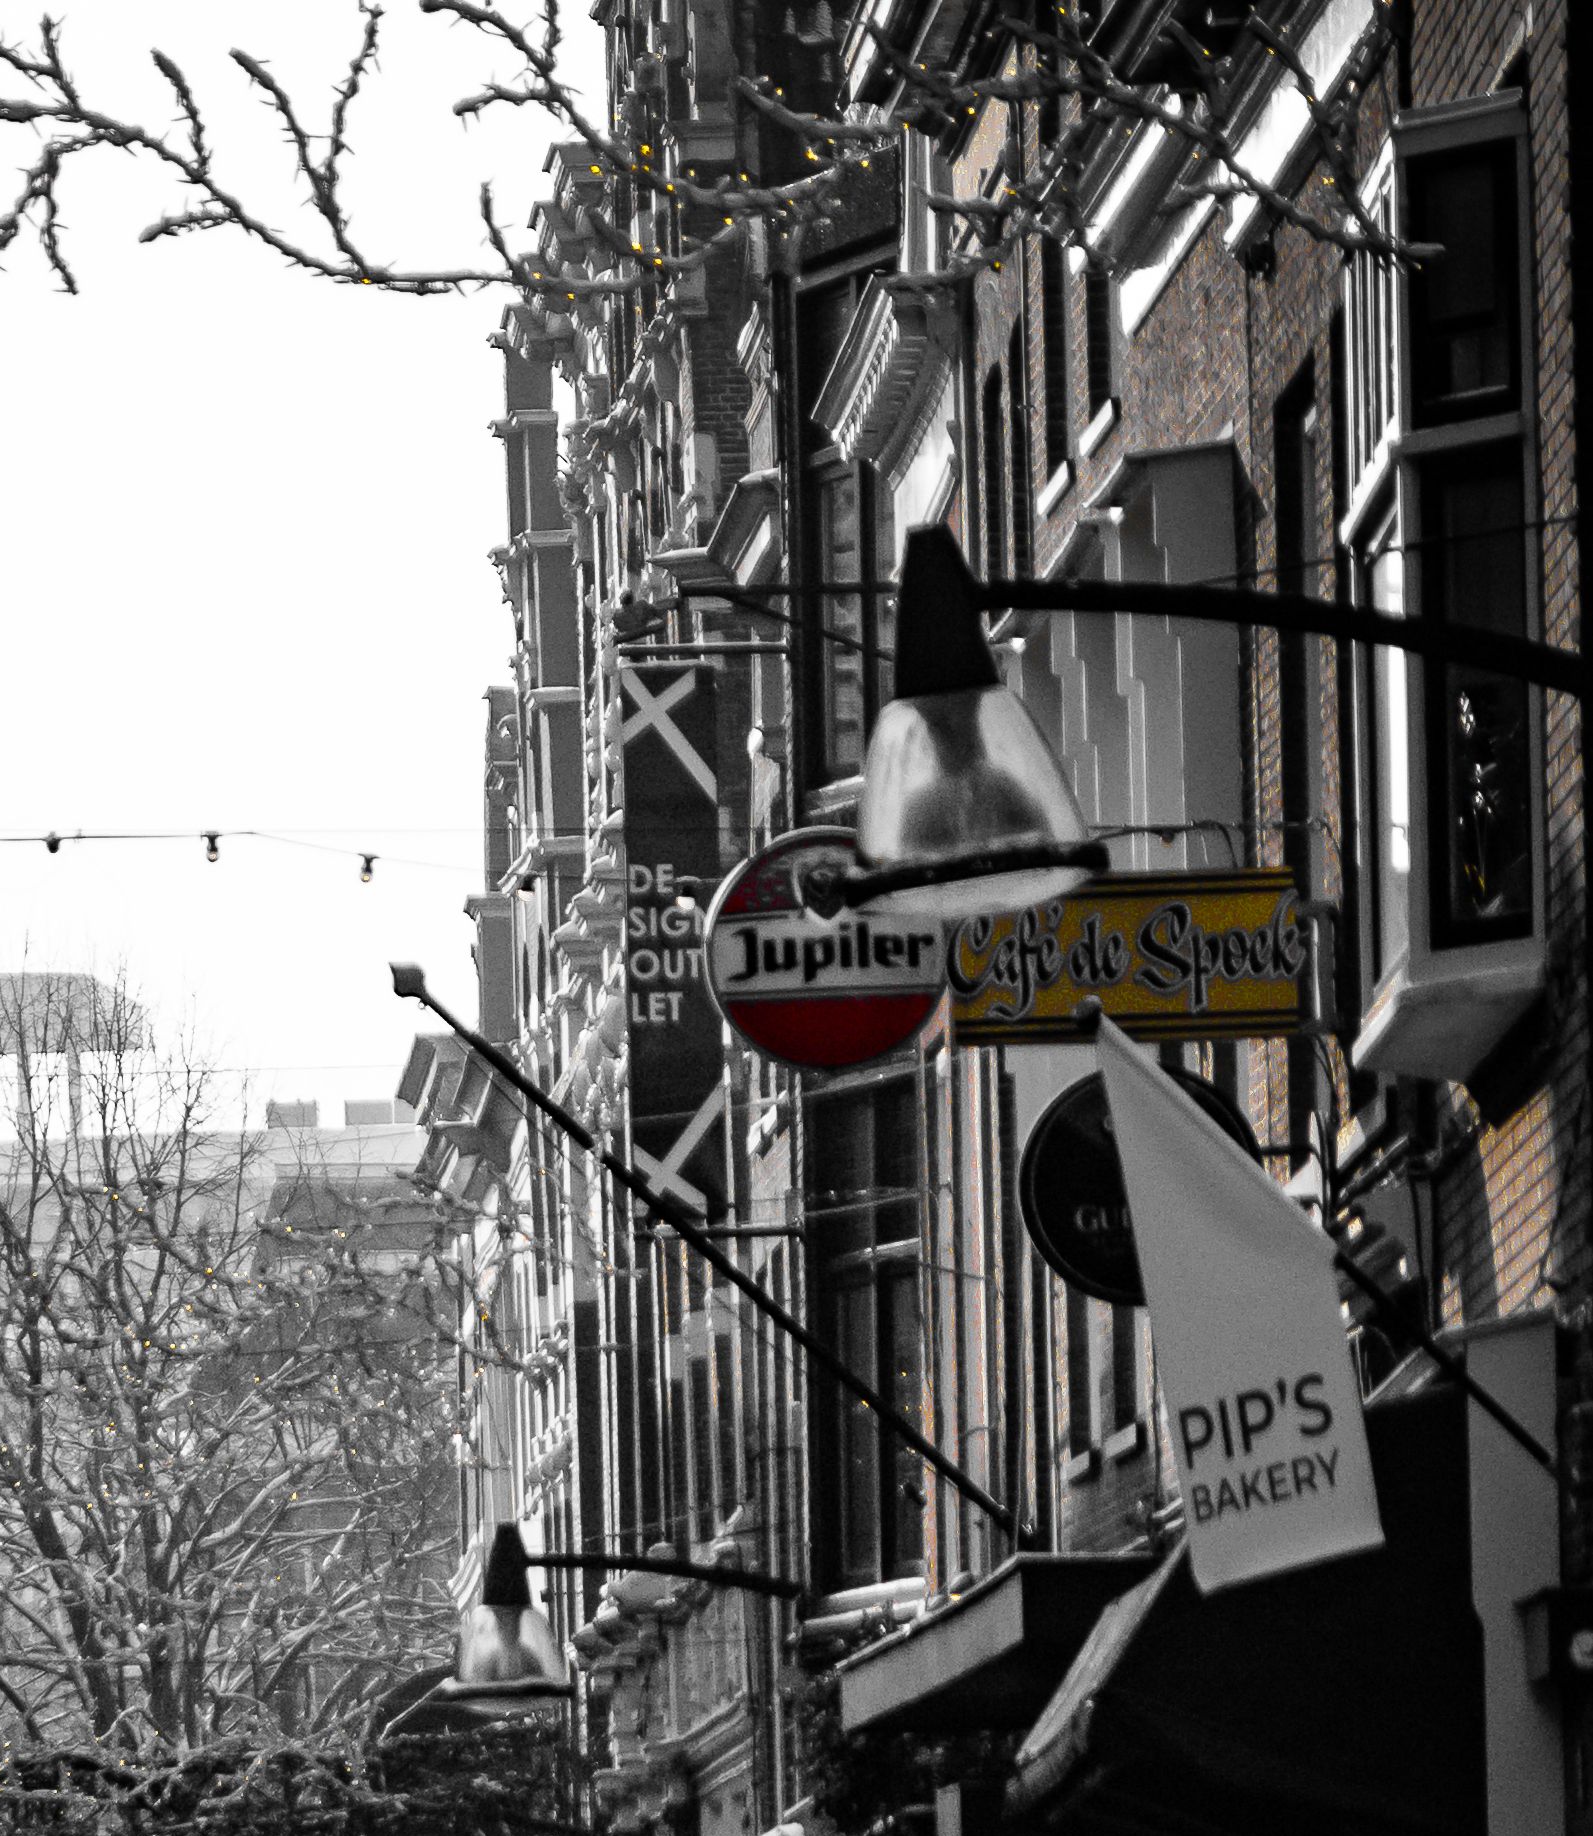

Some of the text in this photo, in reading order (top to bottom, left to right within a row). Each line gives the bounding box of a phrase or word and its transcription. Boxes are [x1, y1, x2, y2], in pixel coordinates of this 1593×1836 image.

[629, 863, 674, 893] DE
[630, 949, 705, 980] OUT
[727, 921, 935, 983] Jupiler
[944, 899, 1306, 1020] Café de Spock
[632, 992, 684, 1023] LET
[1179, 1372, 1333, 1470] PIP'S
[1192, 1447, 1339, 1525] BAKERY
